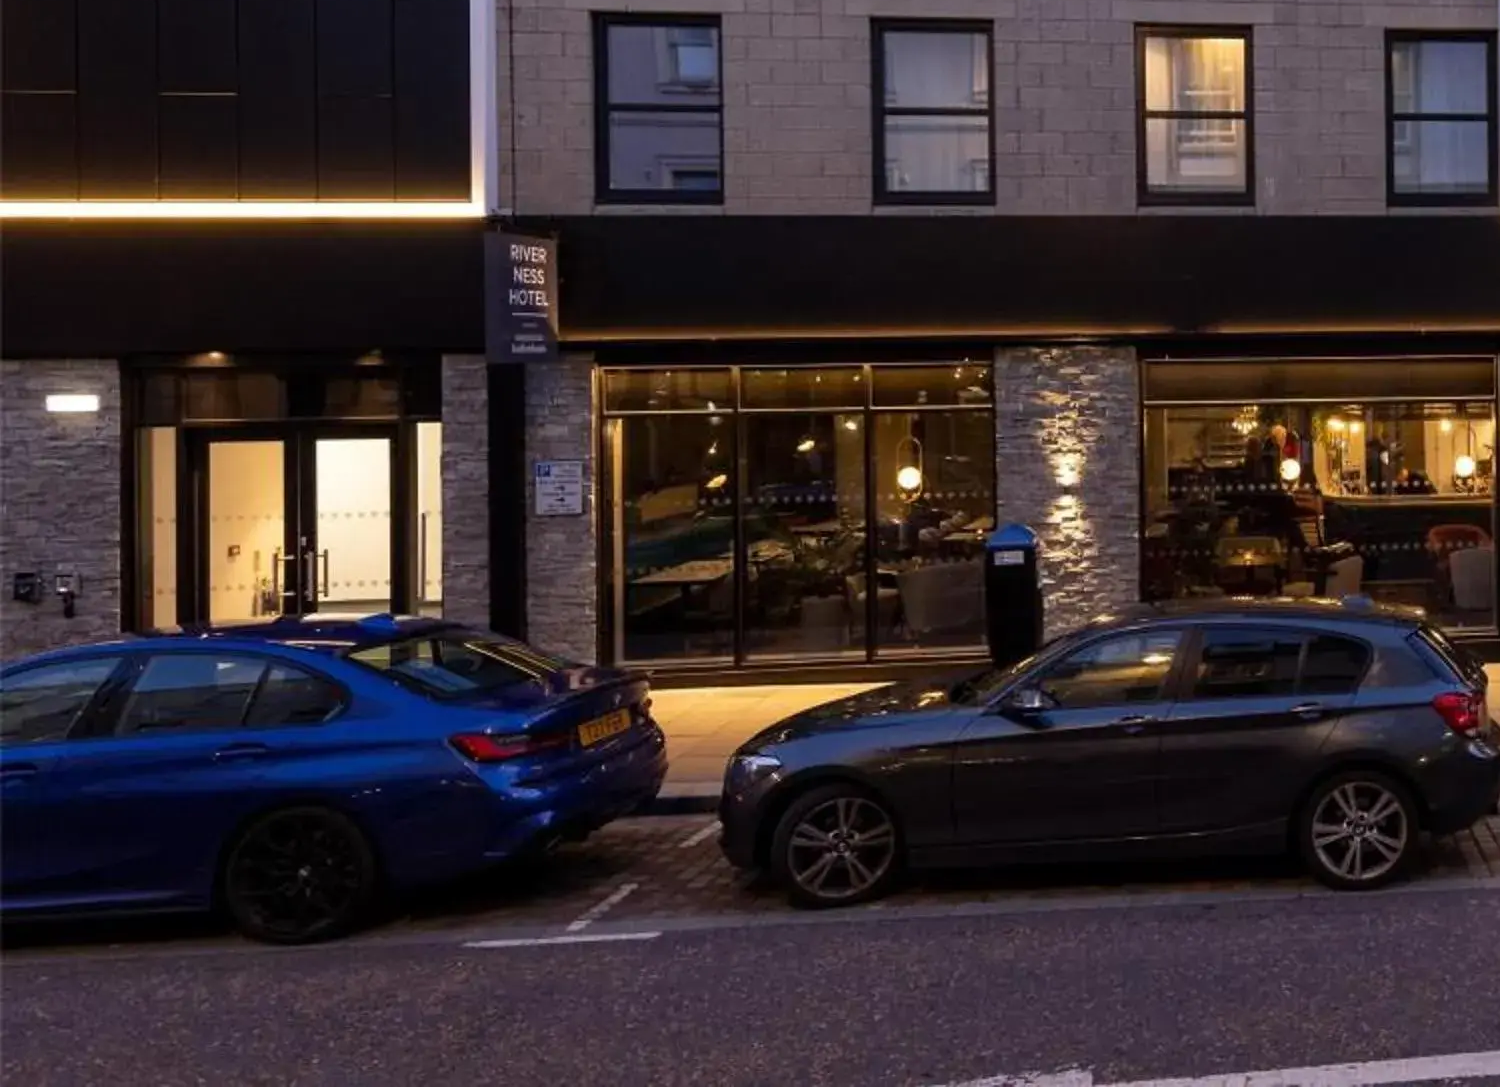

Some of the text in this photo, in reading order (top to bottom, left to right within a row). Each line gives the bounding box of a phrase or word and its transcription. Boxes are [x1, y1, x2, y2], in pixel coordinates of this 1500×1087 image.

[510, 244, 547, 264] RIVER
[513, 267, 545, 285] NESS
[509, 289, 548, 306] HOTEL
